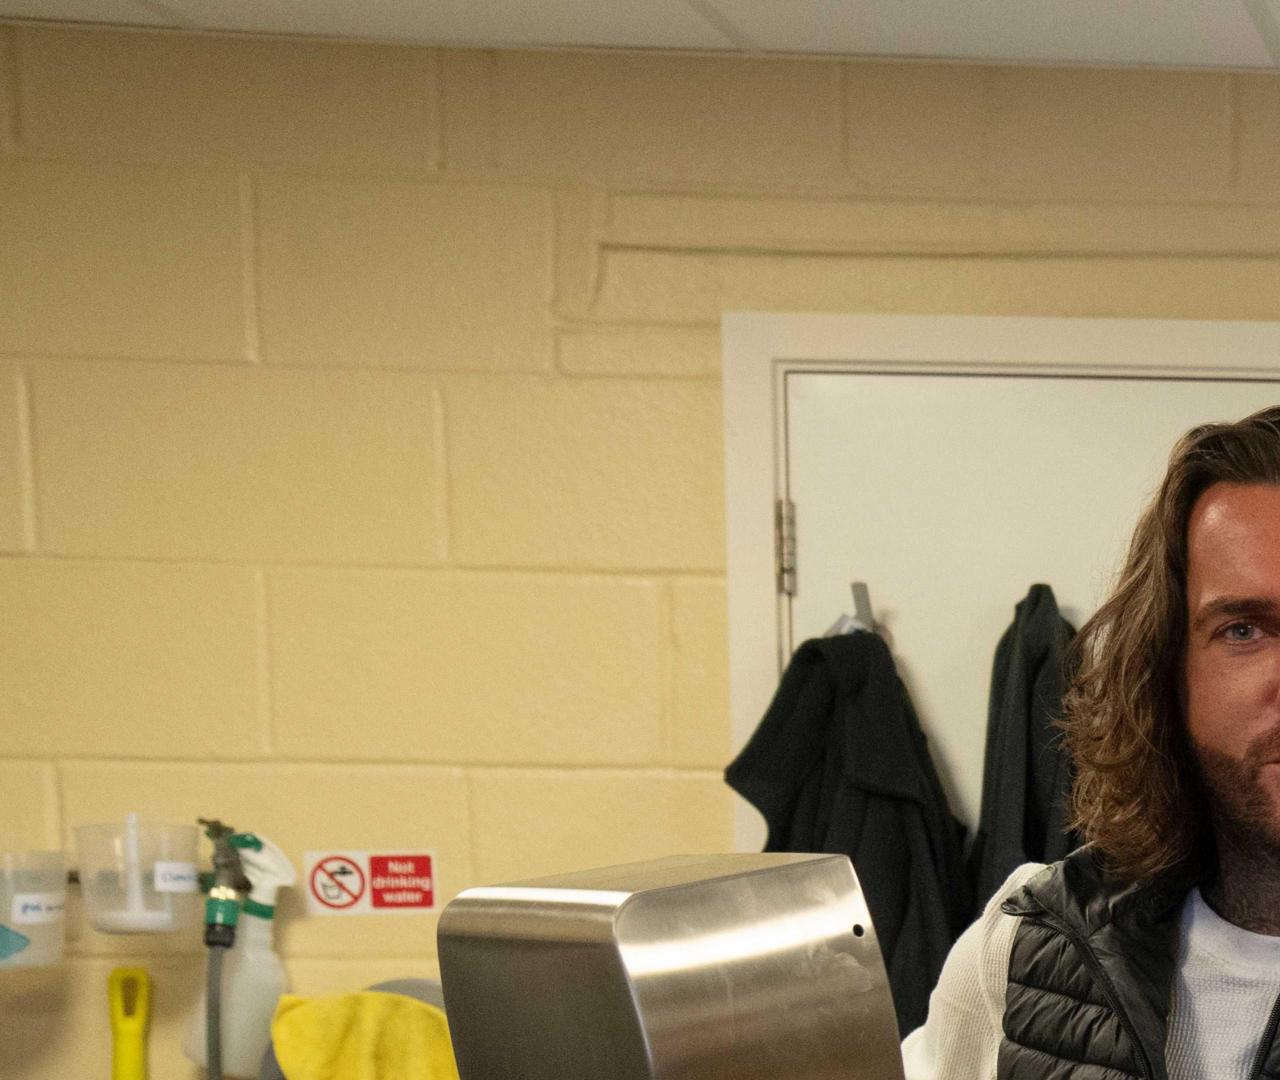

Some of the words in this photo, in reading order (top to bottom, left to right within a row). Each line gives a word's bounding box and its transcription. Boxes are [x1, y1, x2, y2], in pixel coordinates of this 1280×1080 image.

[387, 861, 416, 874] Not
[372, 876, 432, 892] drinking
[382, 891, 423, 904] water
